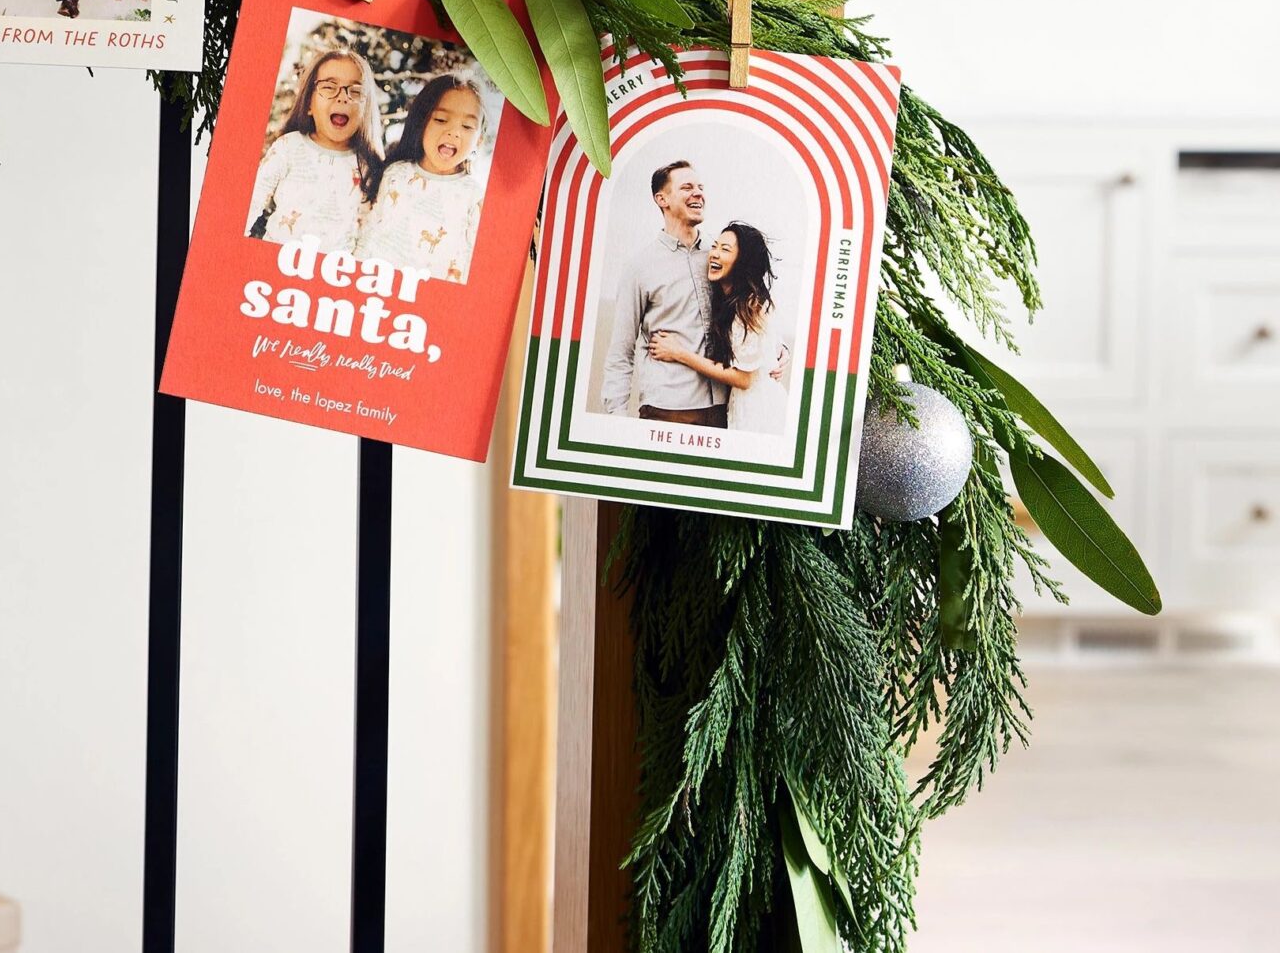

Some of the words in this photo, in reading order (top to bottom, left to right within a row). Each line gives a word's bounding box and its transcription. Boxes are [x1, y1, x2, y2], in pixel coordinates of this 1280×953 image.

[1, 27, 54, 45] FROM
[64, 30, 97, 46] THE
[107, 32, 166, 49] ROTHS
[277, 234, 431, 303] dear
[832, 239, 851, 319] CHRISTMAS
[239, 280, 441, 363] santa,
[252, 335, 280, 358] We
[335, 354, 378, 379] really
[254, 378, 286, 402] love,
[290, 387, 311, 404] the
[315, 392, 352, 412] lopez
[355, 400, 398, 425] family
[650, 429, 673, 443] THE
[680, 433, 721, 449] LANES
